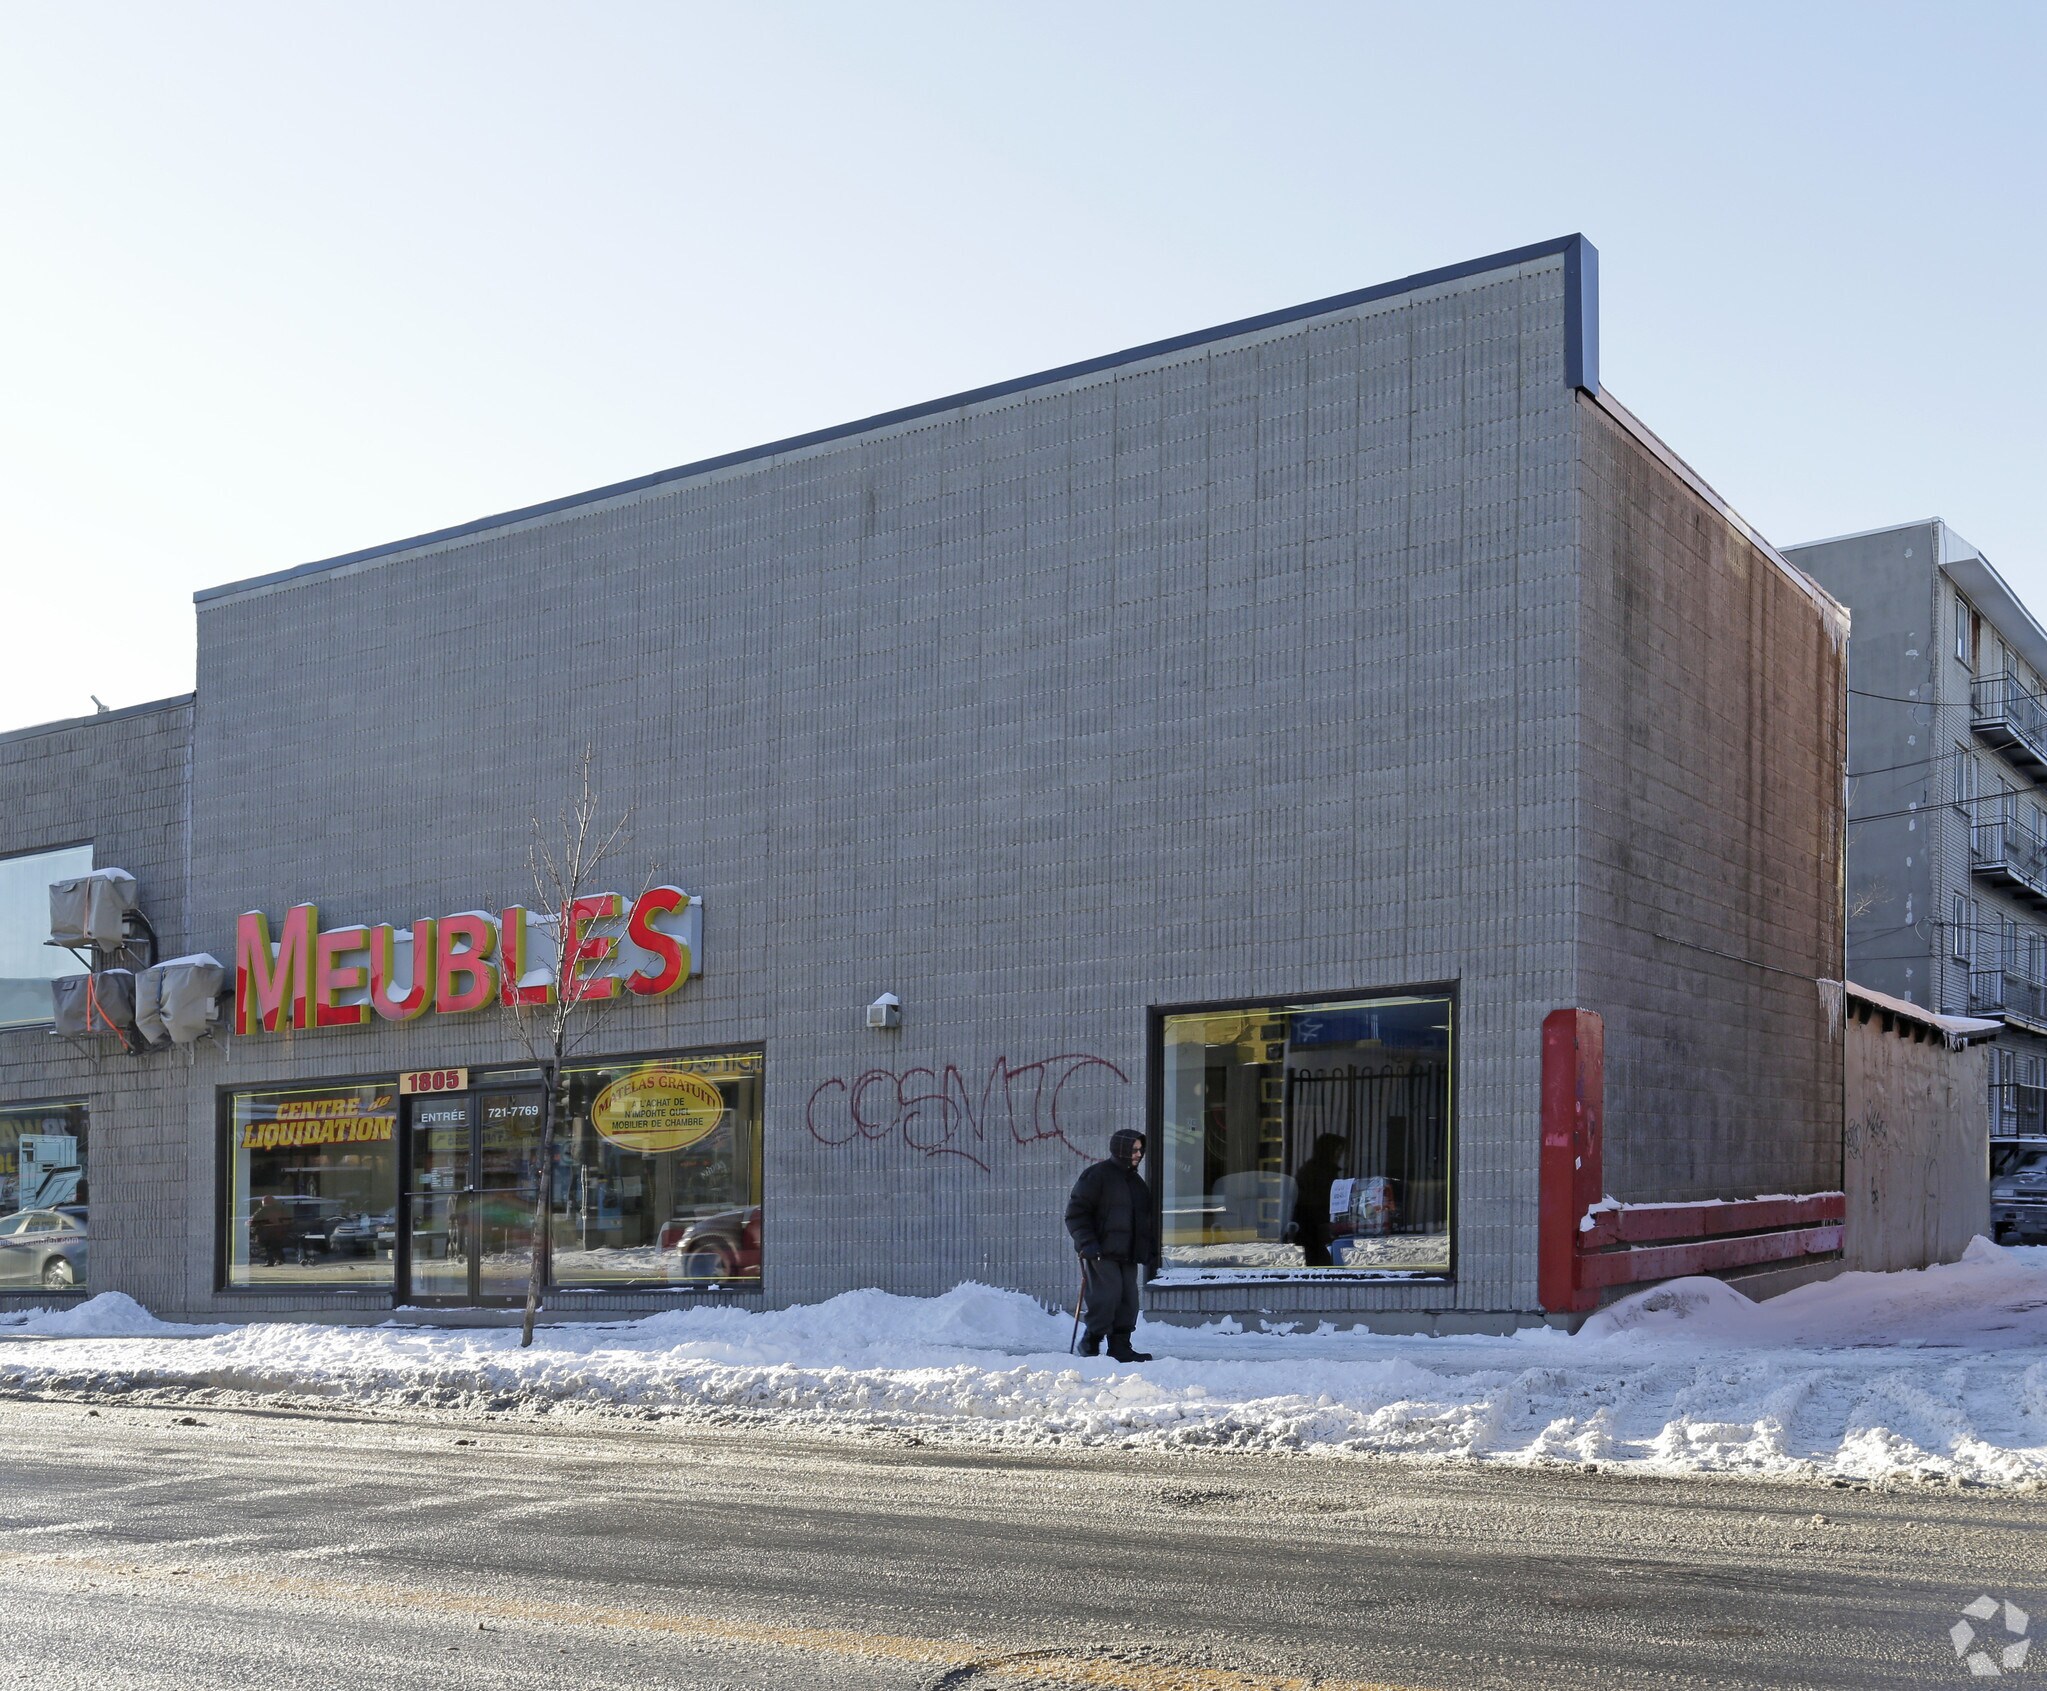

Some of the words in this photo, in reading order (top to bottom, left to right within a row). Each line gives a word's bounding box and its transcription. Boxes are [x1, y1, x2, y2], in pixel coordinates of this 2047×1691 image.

[235, 887, 691, 1036] MEUBLES
[408, 1070, 460, 1092] 1805
[598, 1077, 655, 1116] MATELAS
[674, 1097, 685, 1106] DE
[276, 1098, 361, 1121] CENTRE
[421, 1108, 466, 1122] ENTRÉE
[488, 1105, 539, 1118] 721-7769
[624, 1109, 666, 1119] N'IMPORTE
[669, 1107, 691, 1117] QUEL
[612, 1119, 648, 1130] MOBILIER
[651, 1119, 662, 1128] DE
[665, 1117, 704, 1127] CHAMBRE
[240, 1115, 397, 1151] LIQUIDATION
